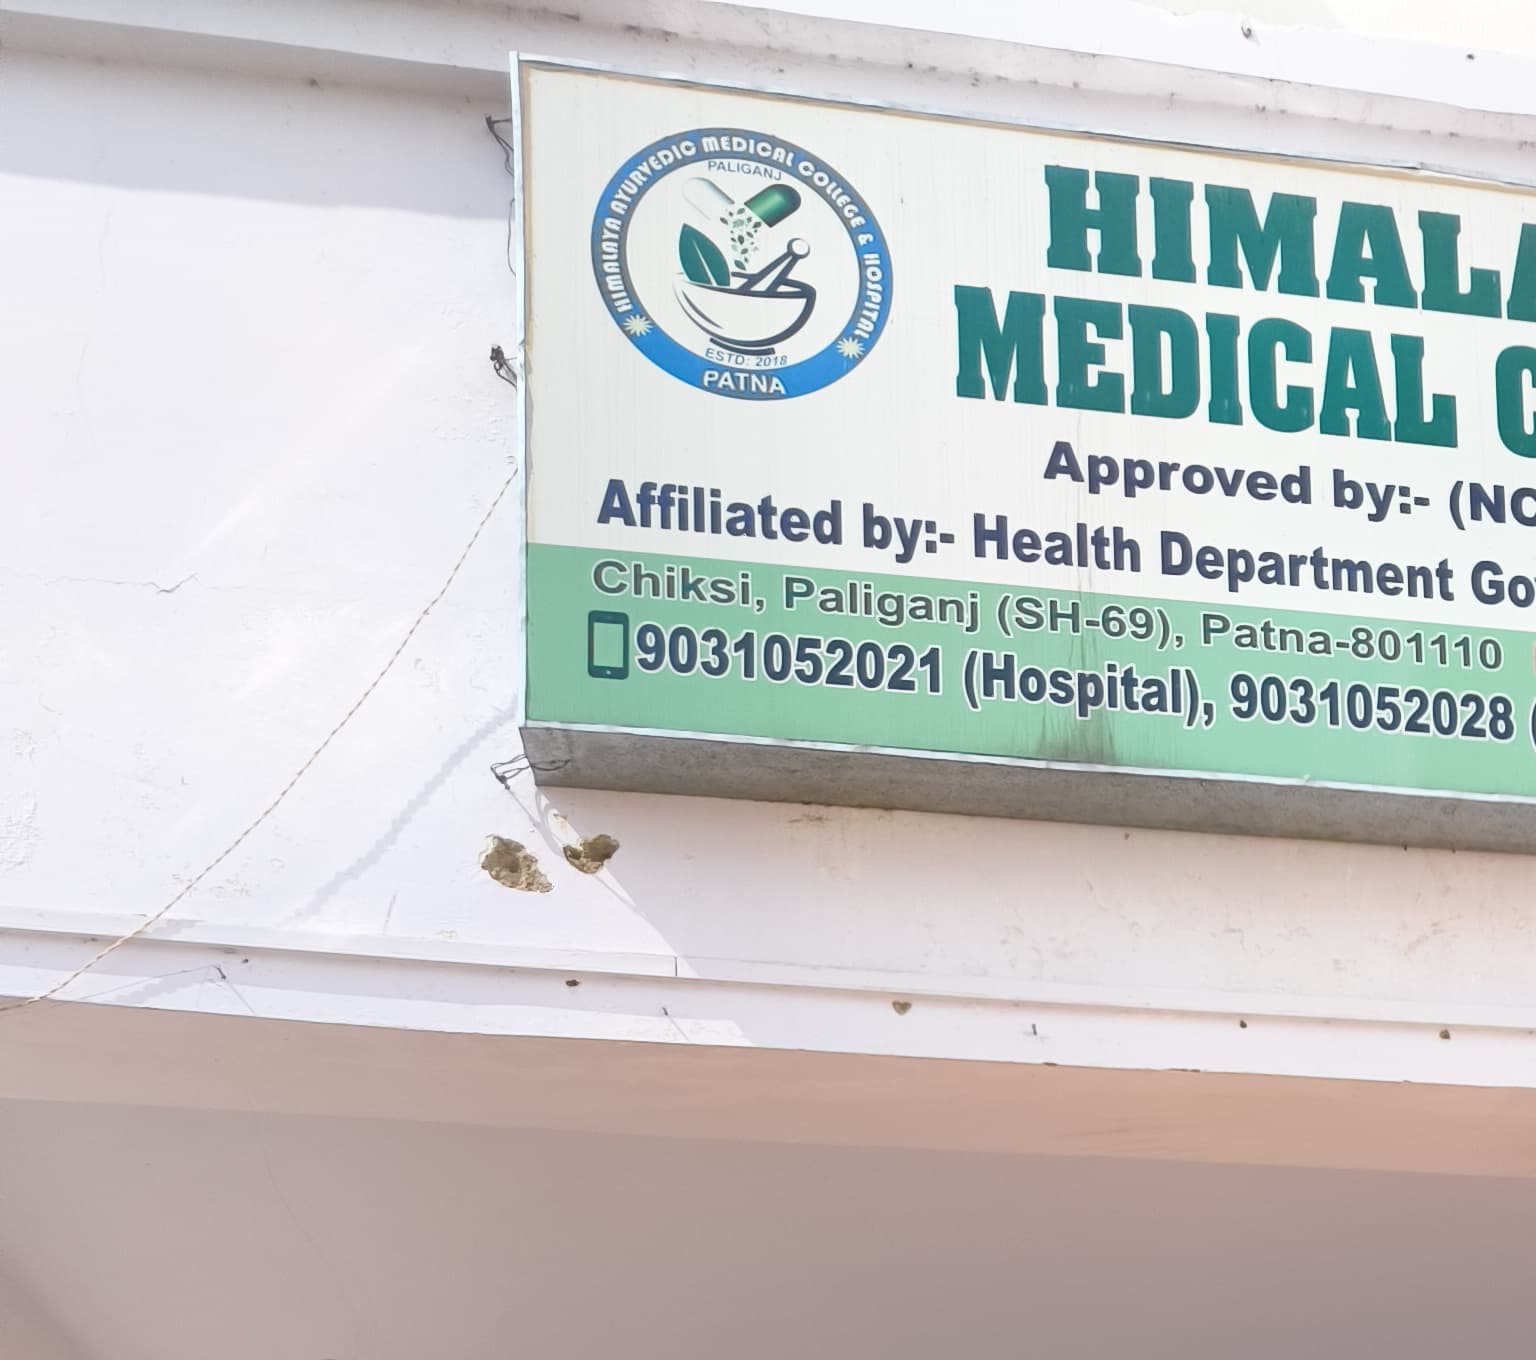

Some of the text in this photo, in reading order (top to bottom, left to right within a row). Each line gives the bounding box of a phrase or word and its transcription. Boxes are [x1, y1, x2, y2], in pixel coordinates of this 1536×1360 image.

[708, 161, 782, 181] PALIGANJ
[602, 136, 884, 339] HIMALAYA AYURVEDIC MEDICAL COLLEGE & HOSPITAL
[703, 369, 786, 394] PATNA
[755, 355, 788, 367] 2018
[953, 284, 1458, 448] MEDICAL
[1043, 441, 1311, 504] Approved
[1333, 469, 1430, 522] by:-
[597, 478, 843, 545] Affiliated
[862, 503, 955, 563] by:-
[973, 512, 1142, 572] Health
[1160, 531, 1454, 602] Department
[591, 560, 766, 612] Chiksi,
[783, 575, 980, 634] Paliganj
[997, 593, 1185, 650] (SH-69),
[1202, 612, 1503, 670] Patna-801110
[635, 624, 942, 694] 9031052021
[963, 649, 1215, 728] (Hospital),
[1230, 673, 1515, 741] 9031052028
